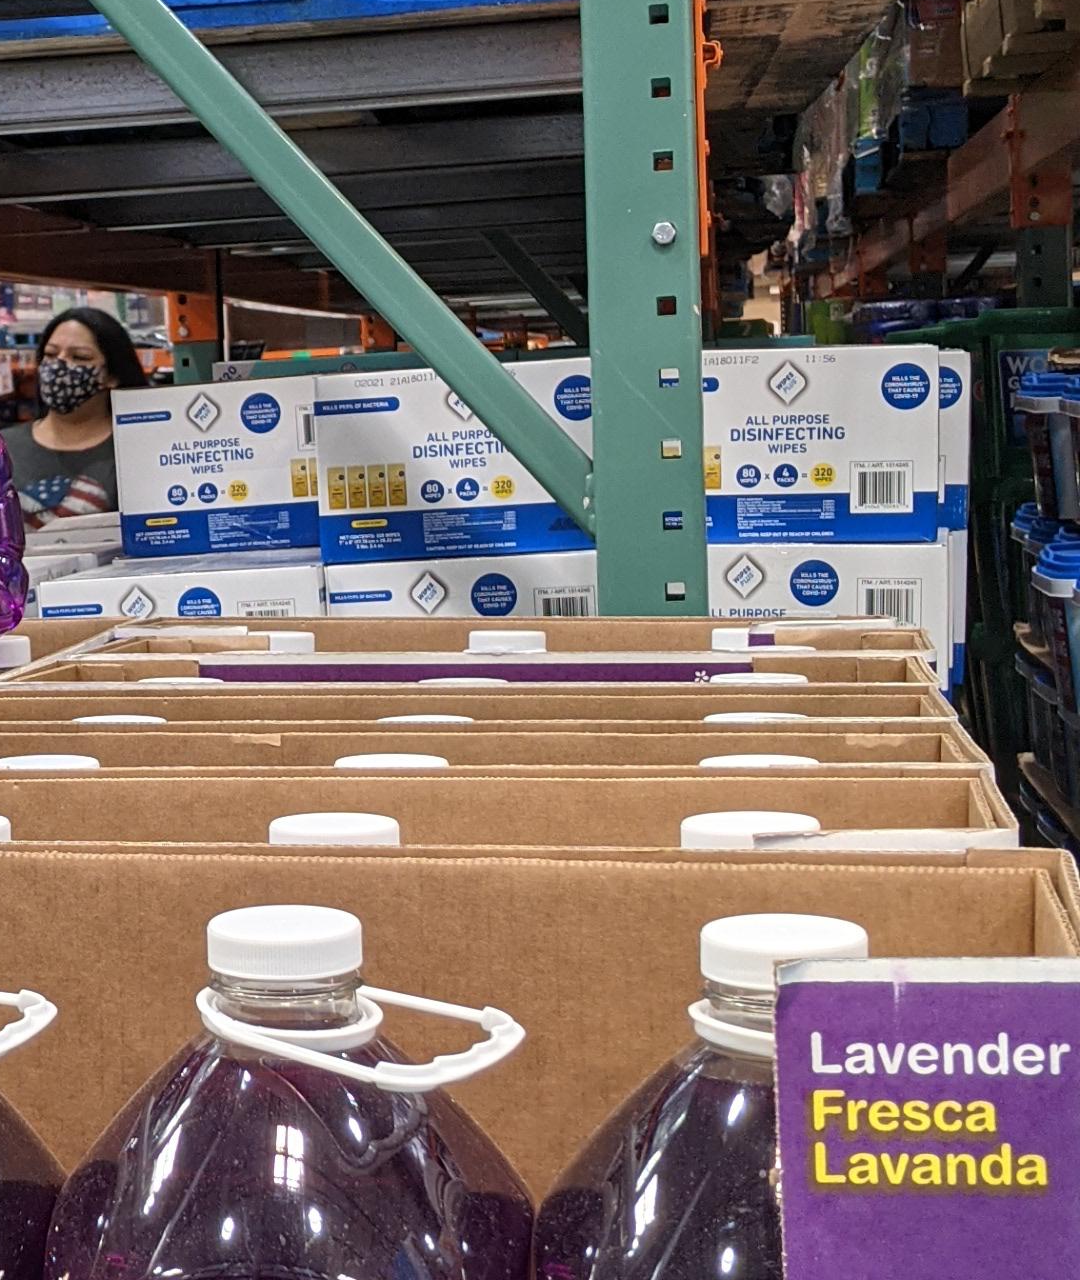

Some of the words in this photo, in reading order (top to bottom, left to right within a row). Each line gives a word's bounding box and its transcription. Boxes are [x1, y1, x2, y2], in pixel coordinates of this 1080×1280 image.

[805, 354, 837, 364] 11:56
[745, 415, 769, 426] ALL
[772, 414, 830, 425] PURPOSE
[426, 432, 449, 443] ALL
[730, 426, 846, 442] DISINFECTING
[171, 441, 191, 452] ALL
[193, 438, 240, 450] PURPOSE
[768, 443, 807, 454] WIPES
[159, 448, 255, 467] DISINFECTING
[449, 458, 487, 468] WIPES
[191, 464, 224, 475] WIPES
[742, 468, 755, 478] 80
[814, 468, 833, 477] 320
[426, 484, 439, 494] 80
[494, 480, 512, 489] 320
[171, 487, 183, 496] 80
[729, 608, 787, 617] PURPOSE
[811, 1032, 1071, 1075] Lavender
[812, 1089, 997, 1132] Fresca
[814, 1142, 1048, 1186] Lavanda
